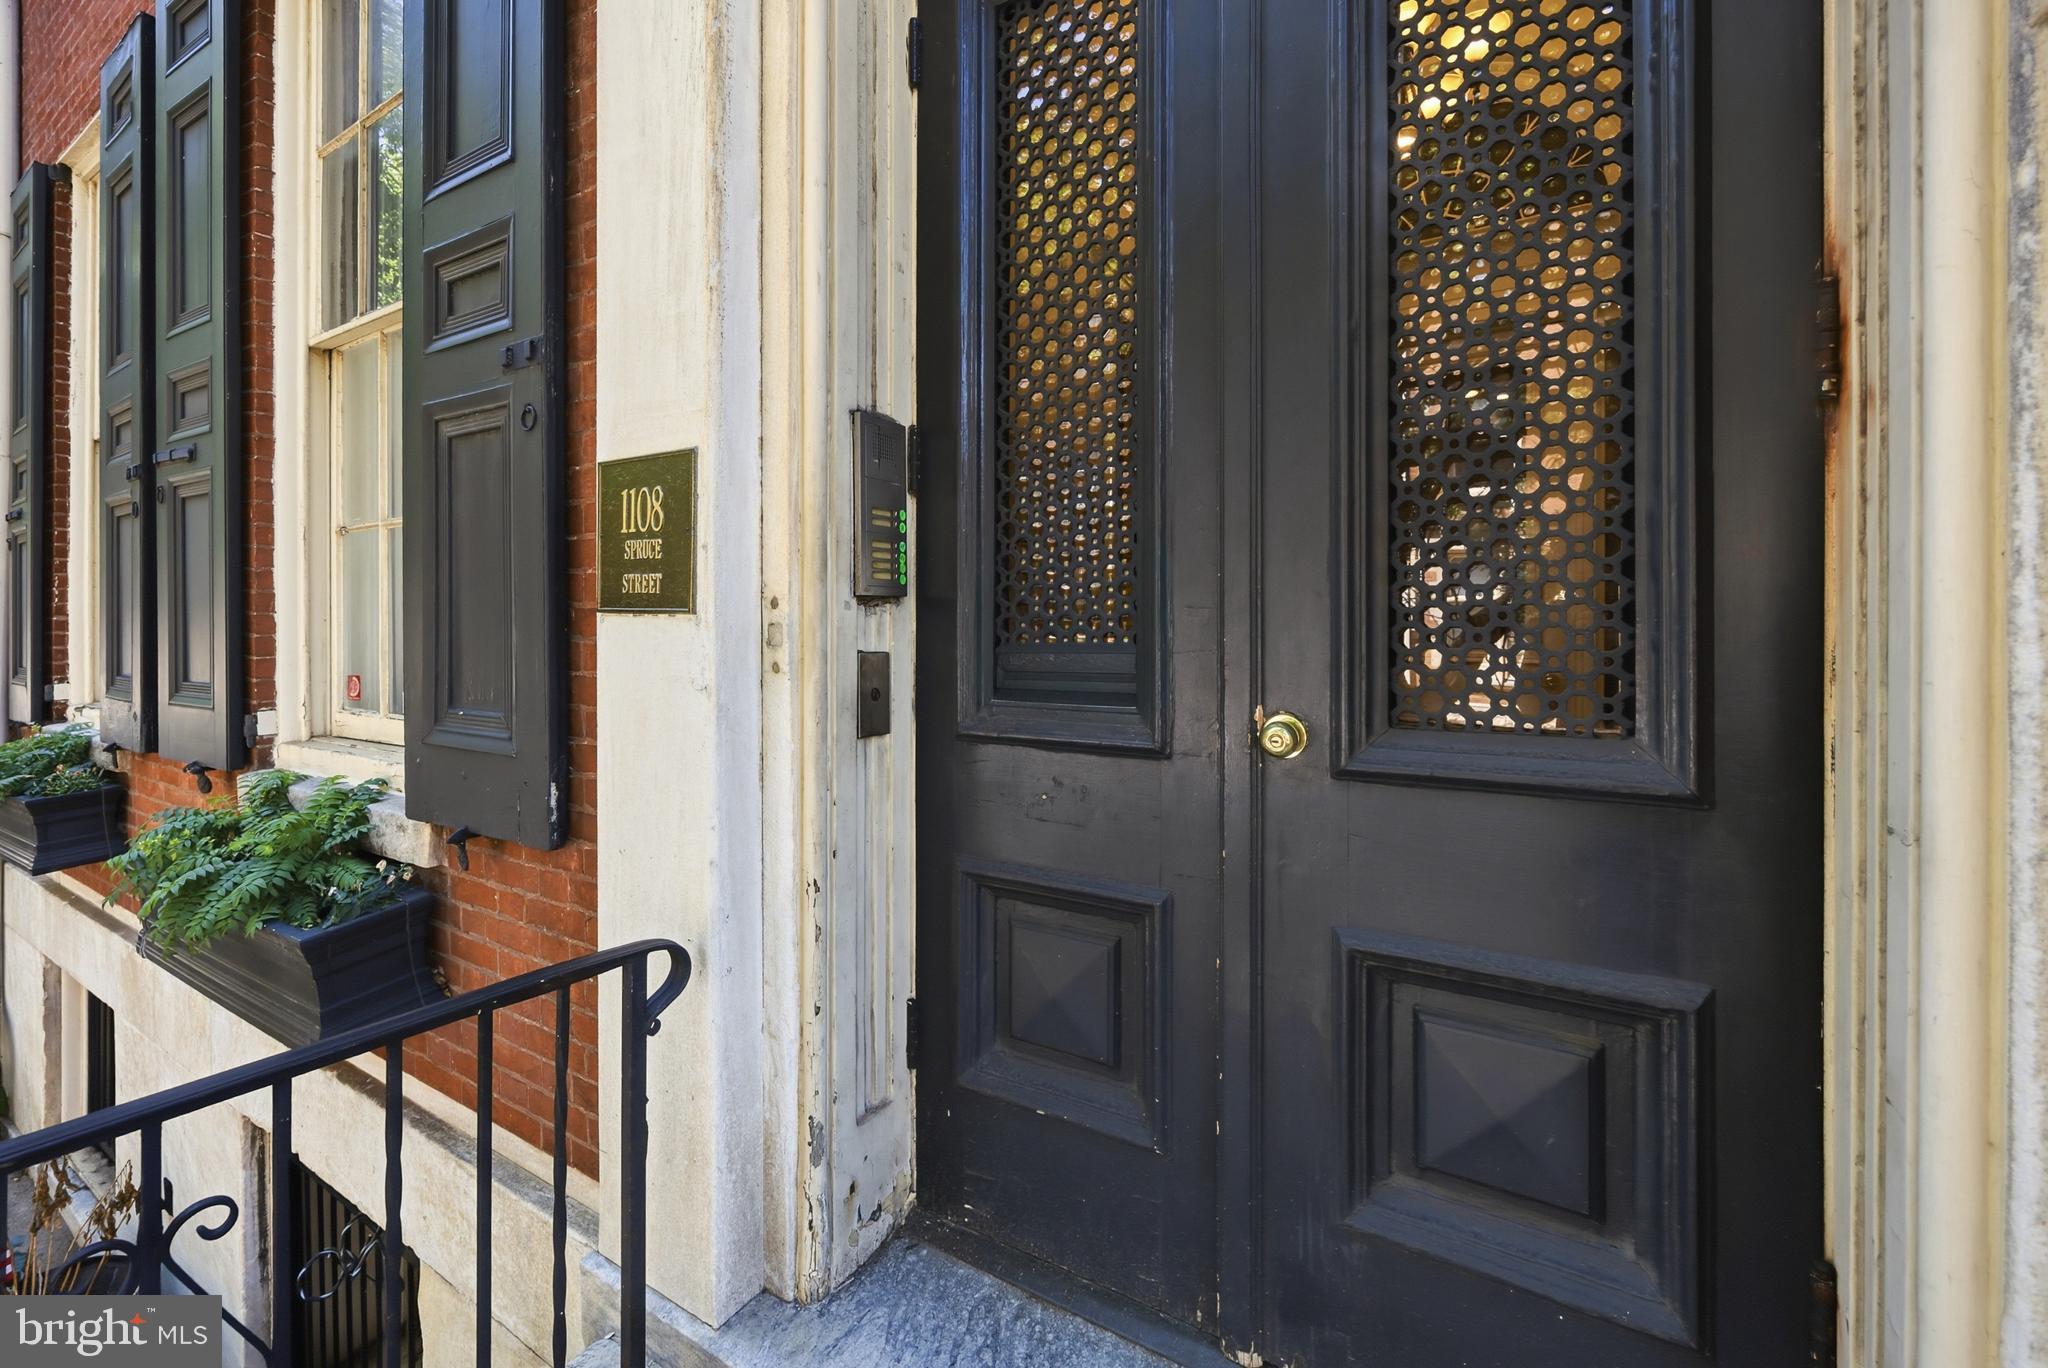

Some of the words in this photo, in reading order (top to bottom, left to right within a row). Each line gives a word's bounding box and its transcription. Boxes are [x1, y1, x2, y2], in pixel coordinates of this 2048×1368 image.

[620, 485, 664, 534] 1108
[624, 538, 663, 560] SPRUCE
[622, 573, 663, 594] STREET
